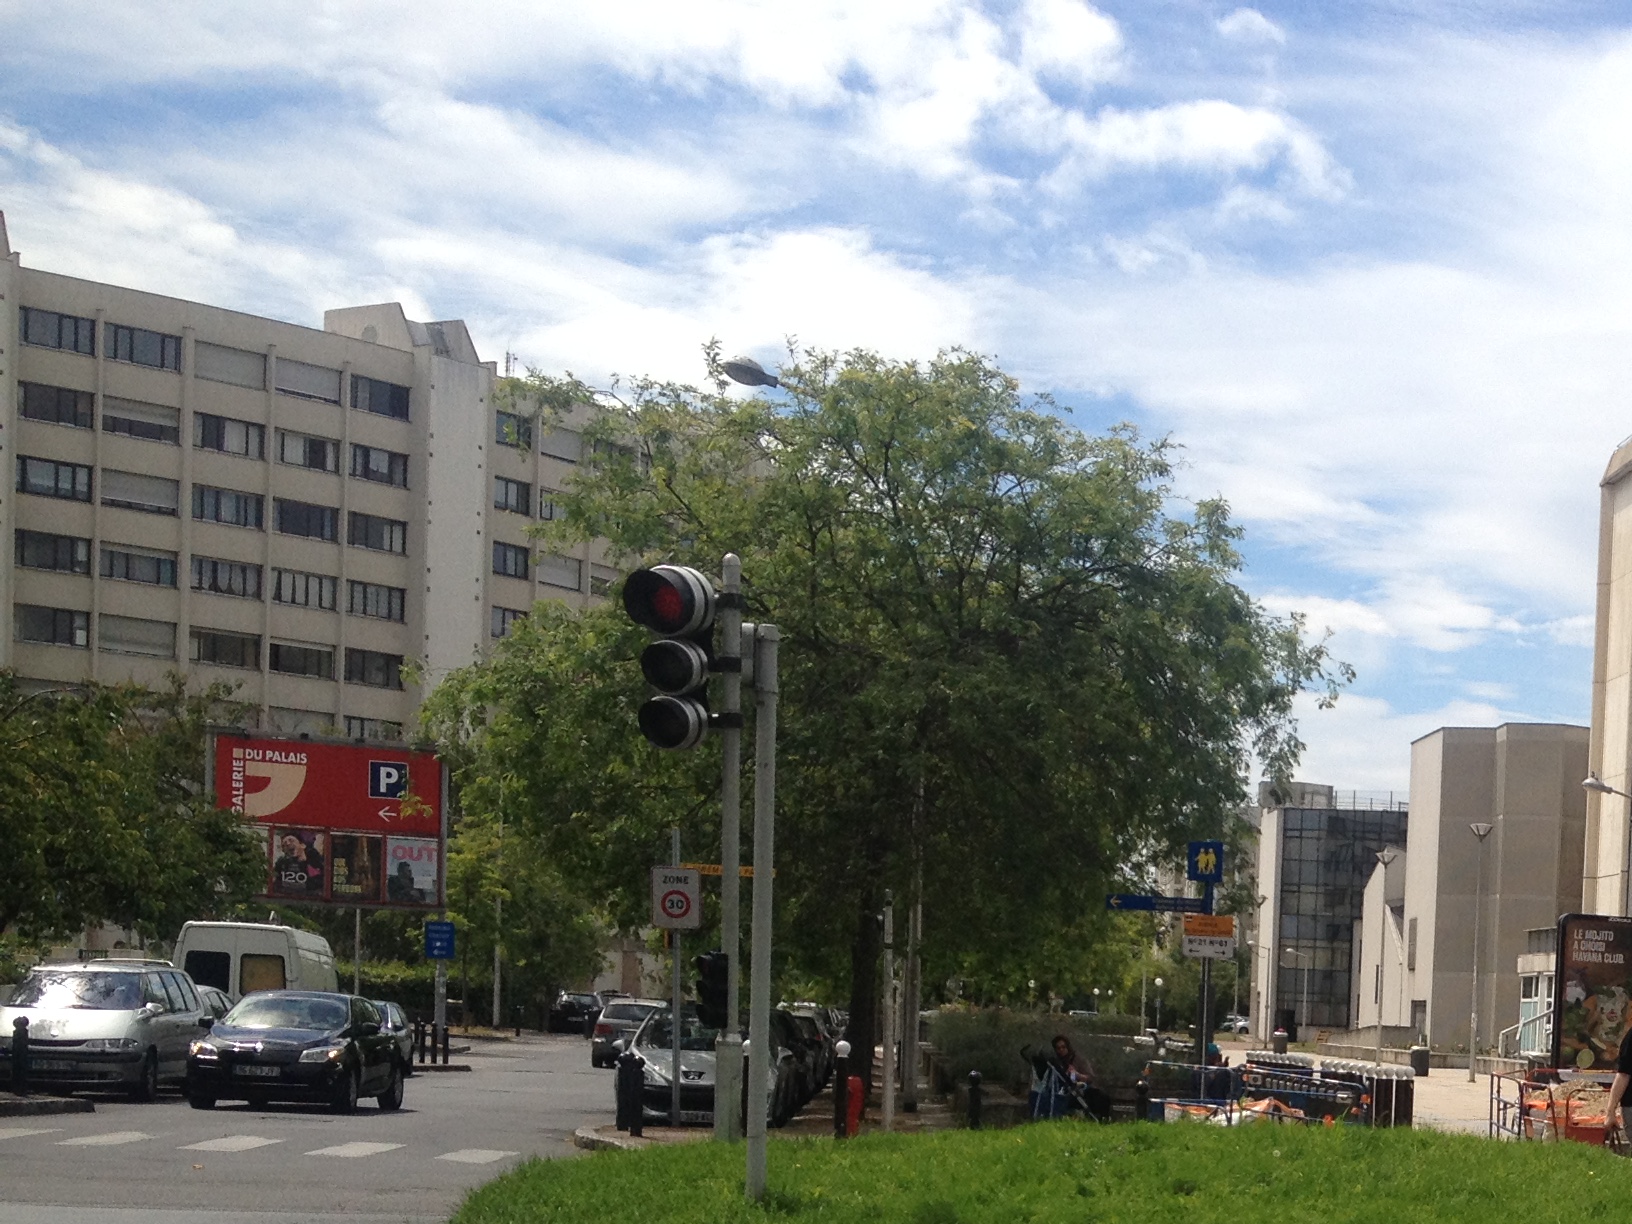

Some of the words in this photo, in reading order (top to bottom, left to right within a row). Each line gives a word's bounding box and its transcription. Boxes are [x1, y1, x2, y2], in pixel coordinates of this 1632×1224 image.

[245, 748, 263, 760] DU
[265, 750, 308, 764] PALAIS
[379, 766, 399, 793] P
[280, 871, 308, 883] 120
[662, 875, 689, 885] ZONE
[667, 898, 685, 910] 30
[1574, 929, 1583, 940] LE
[1585, 930, 1614, 941] MOJITO
[1573, 941, 1579, 950] A
[1580, 940, 1606, 951] CHOISI
[1572, 951, 1602, 962] HAVANA
